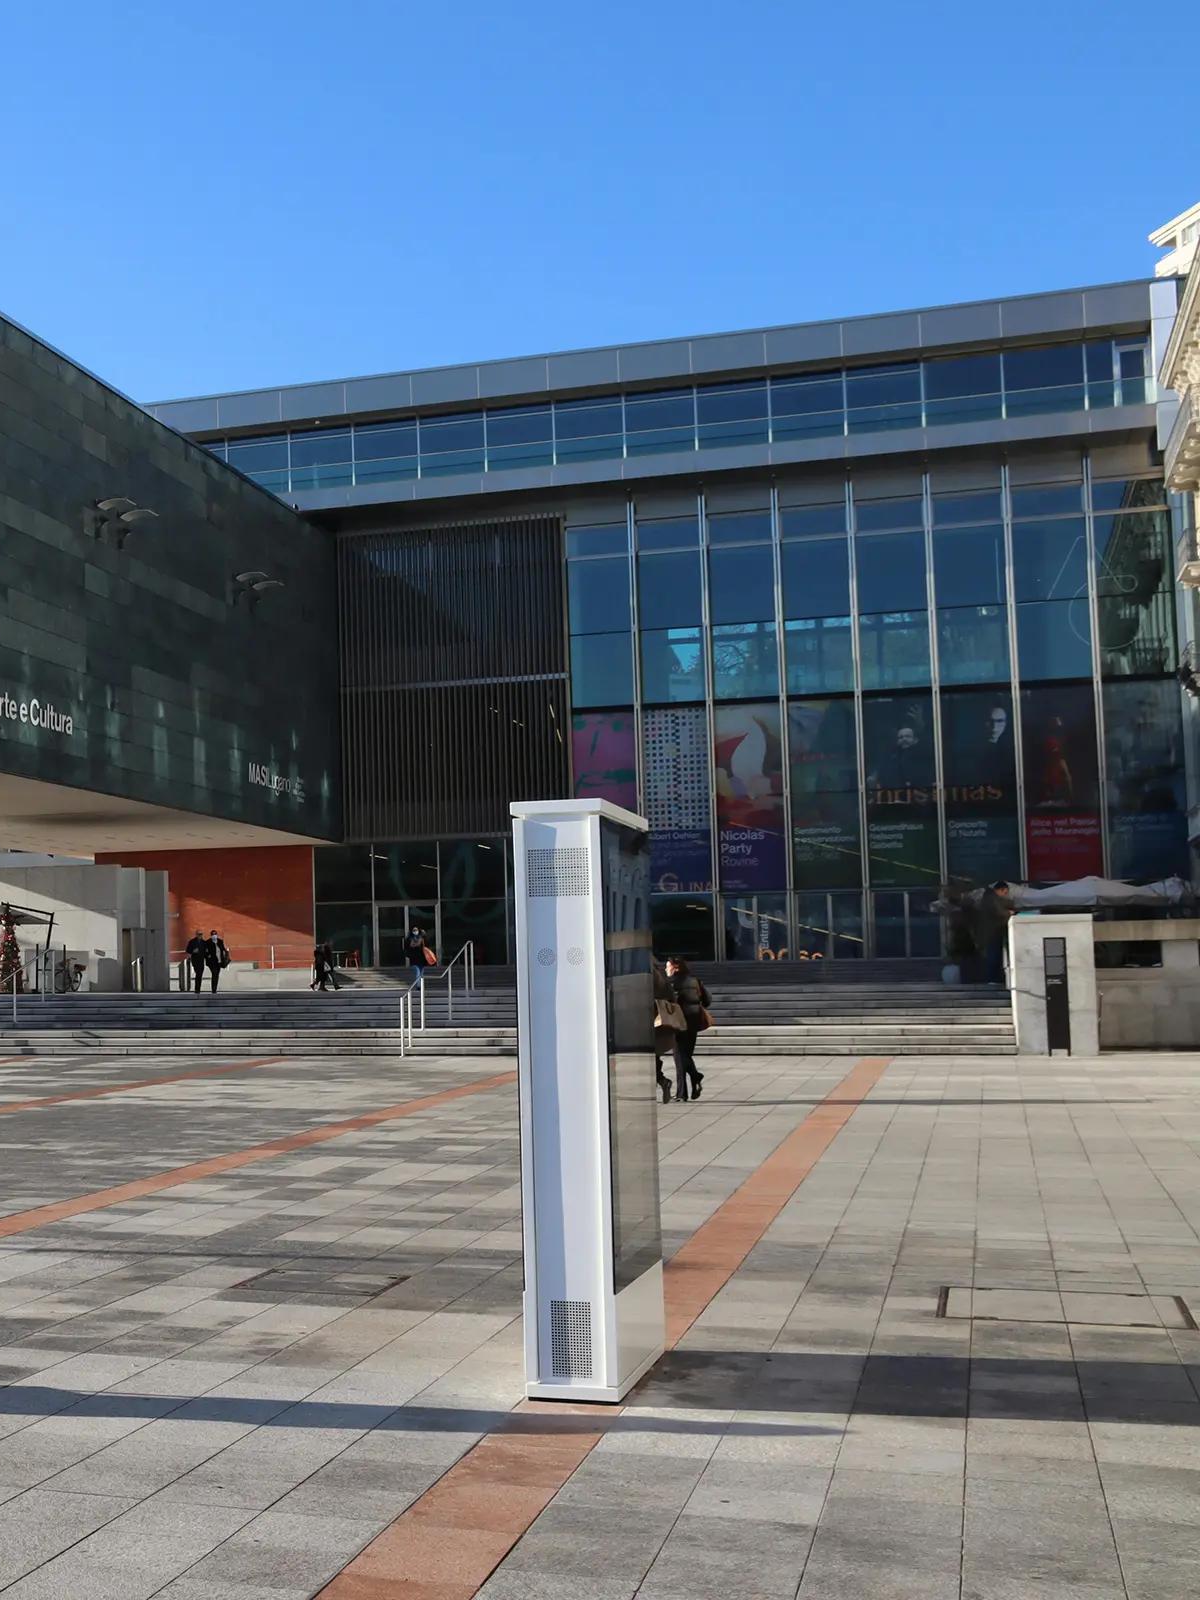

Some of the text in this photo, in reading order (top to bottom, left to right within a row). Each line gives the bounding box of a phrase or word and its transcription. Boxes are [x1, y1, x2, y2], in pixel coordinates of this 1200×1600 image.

[19, 703, 28, 723] e
[29, 698, 73, 735] Cultura
[720, 831, 765, 842] Nicolas
[720, 843, 752, 855] Party
